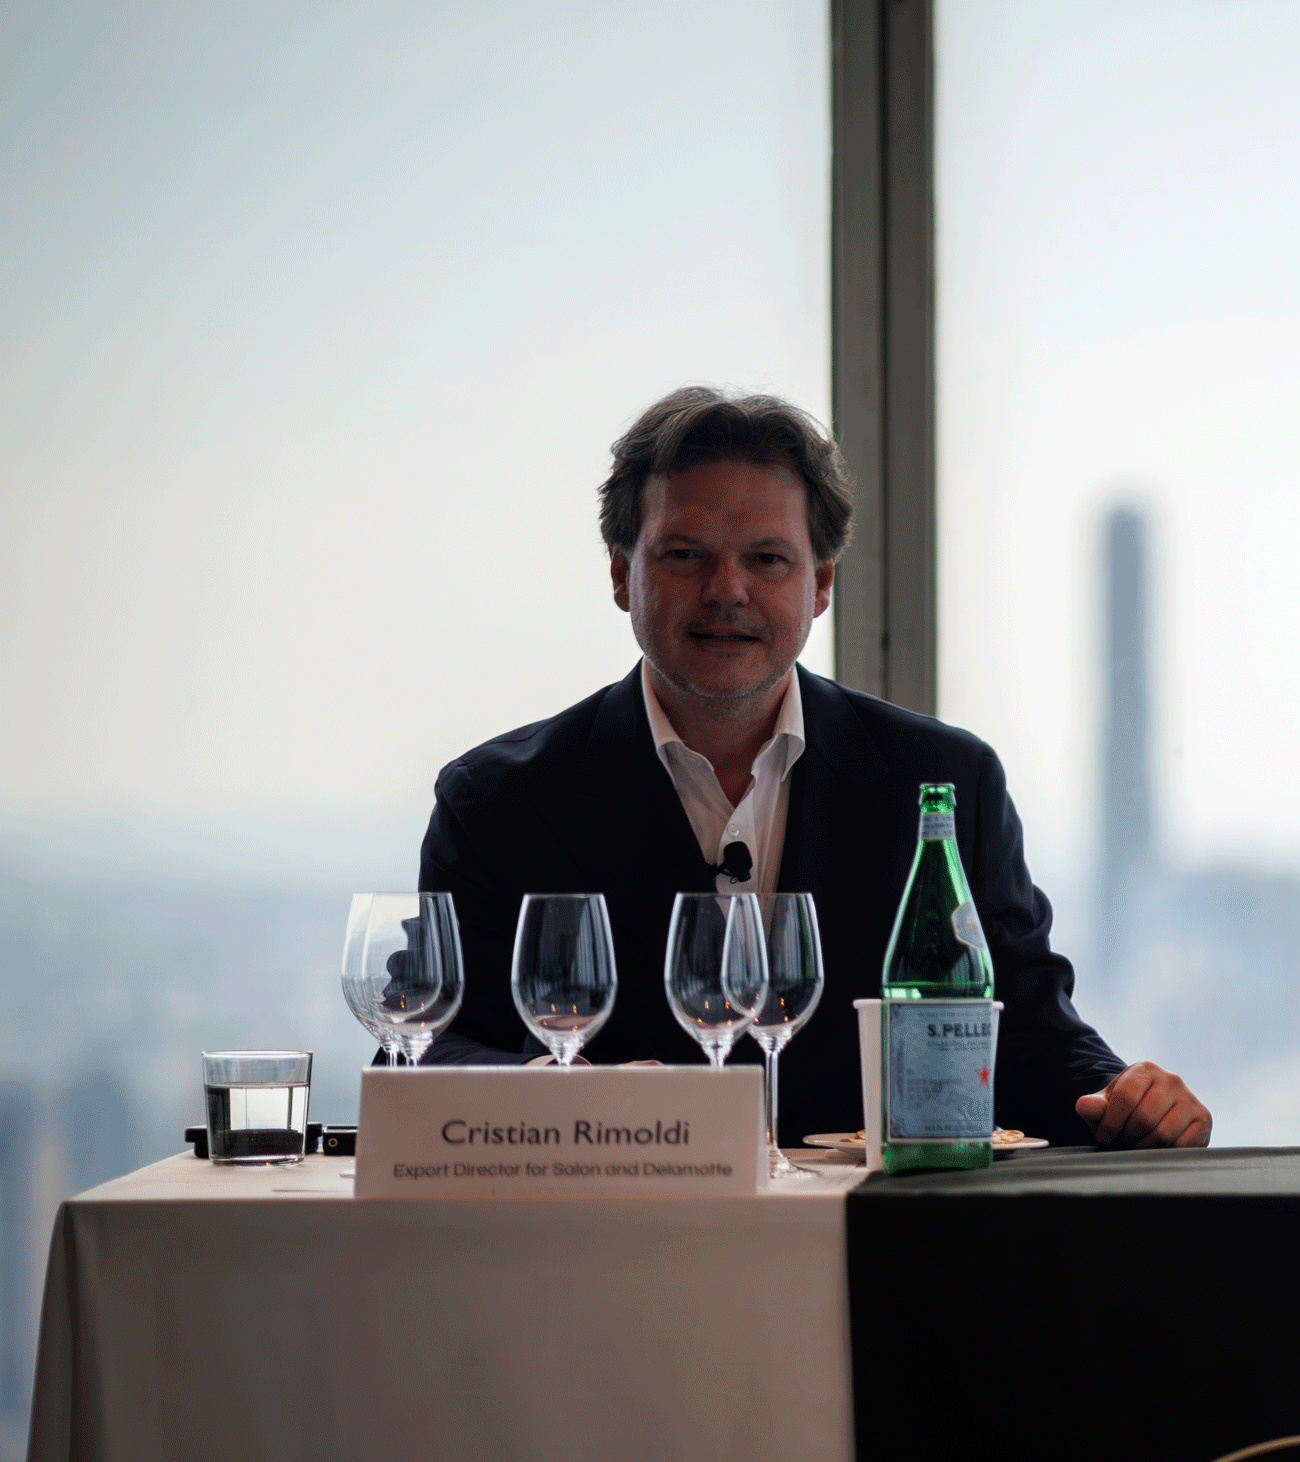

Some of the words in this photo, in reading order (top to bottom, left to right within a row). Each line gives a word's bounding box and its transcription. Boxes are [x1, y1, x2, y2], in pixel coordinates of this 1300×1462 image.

[441, 1119, 561, 1145] Cristian
[574, 1119, 691, 1145] Rimoldi
[393, 1162, 449, 1180] Export
[453, 1162, 522, 1178] Director
[525, 1162, 547, 1177] for
[552, 1162, 601, 1177] Salon
[605, 1162, 639, 1177] and
[642, 1161, 733, 1177] Delamotte
